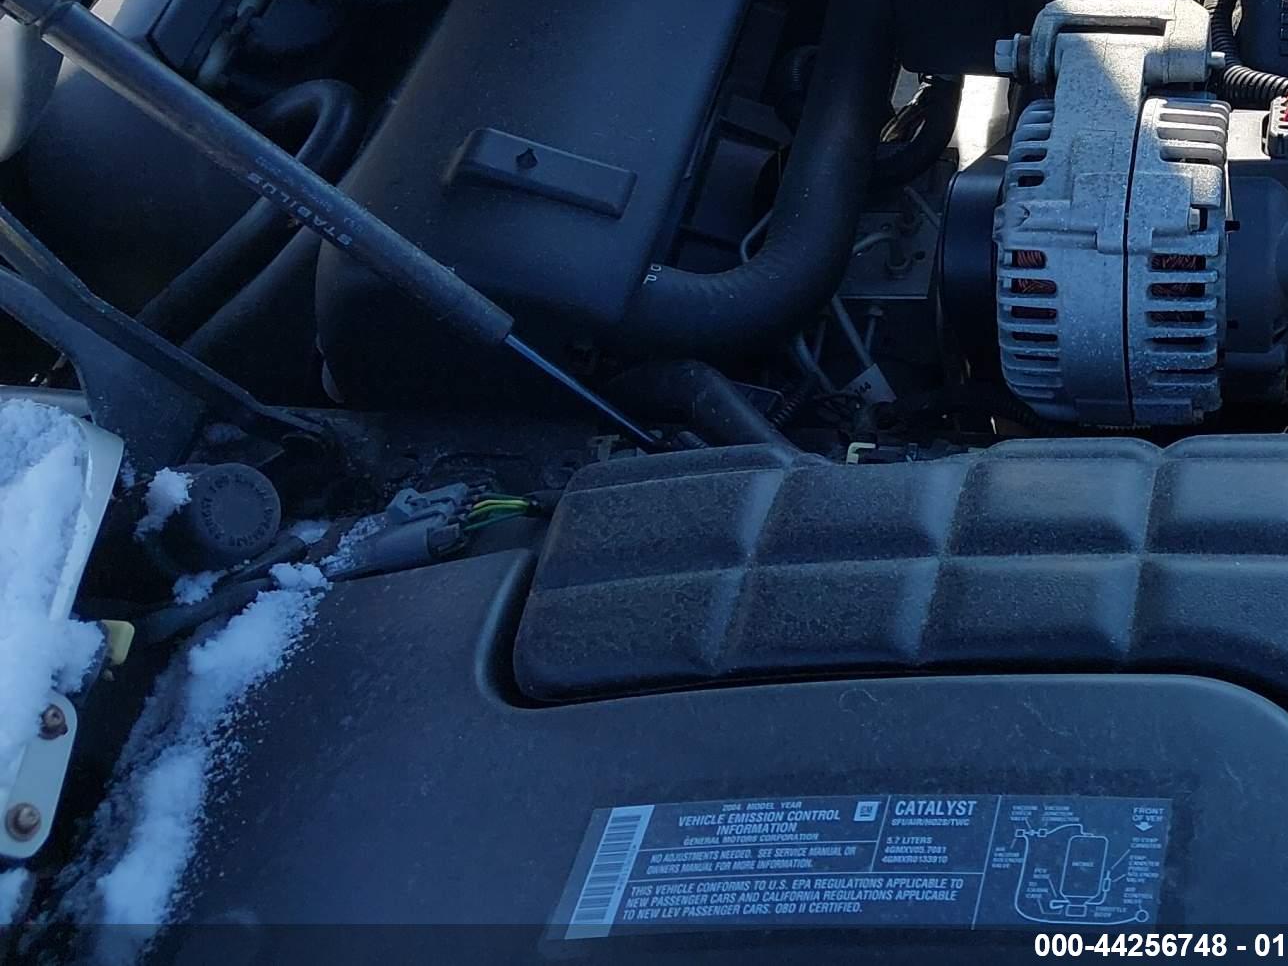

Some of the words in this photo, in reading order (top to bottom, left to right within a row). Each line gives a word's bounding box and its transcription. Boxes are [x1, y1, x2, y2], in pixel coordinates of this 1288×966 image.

[247, 172, 353, 246] STABILUS
[745, 802, 775, 810] MODEL
[780, 801, 801, 809] YEAR
[895, 800, 978, 816] CATALYST
[1132, 807, 1165, 815] FRONT
[678, 814, 725, 827] VEHICLE
[727, 811, 783, 824] EMISSION
[787, 809, 841, 821] CONTROL
[715, 822, 798, 836] INFORMATION
[683, 836, 720, 846] GENERAL
[721, 834, 757, 844] MOTORS
[759, 832, 818, 843] CORPORATION
[886, 836, 901, 845] 5.7
[902, 836, 933, 845] LITERS
[650, 853, 663, 864] NO
[662, 850, 720, 863] ADJUSTMENTS
[756, 848, 772, 858] SEE
[774, 847, 809, 858] SERVICE
[808, 846, 842, 857] MANUAL
[843, 846, 856, 856] OR
[646, 864, 680, 875] OWNERS
[680, 862, 713, 873] MANUAL
[713, 861, 732, 871] FOR
[732, 860, 757, 871] MORE
[629, 886, 653, 897] THIS
[655, 884, 693, 895] VEHICLE
[696, 882, 750, 893] CONFORMS
[752, 881, 767, 890] TO
[769, 879, 789, 890] U.S.
[791, 879, 810, 890] EPA
[814, 878, 883, 889] REGULATIONS
[886, 878, 946, 889] APPLICABLE
[949, 878, 964, 889] TO
[625, 897, 650, 908] NEW
[650, 894, 708, 907] PASSENGER
[709, 893, 737, 905] CARS
[737, 892, 760, 903] AND
[761, 891, 820, 903] CALIFORNIA
[822, 890, 893, 901] REGULATIONS
[895, 890, 958, 901] APPLICABLE
[622, 909, 636, 920] TO
[636, 908, 660, 920] NEW
[661, 906, 682, 918] LEV
[681, 904, 741, 917] PASSENGER
[742, 904, 770, 915] CARS.
[774, 903, 797, 914] OBD
[799, 902, 807, 913] II
[808, 902, 863, 914] CERTIFIED.
